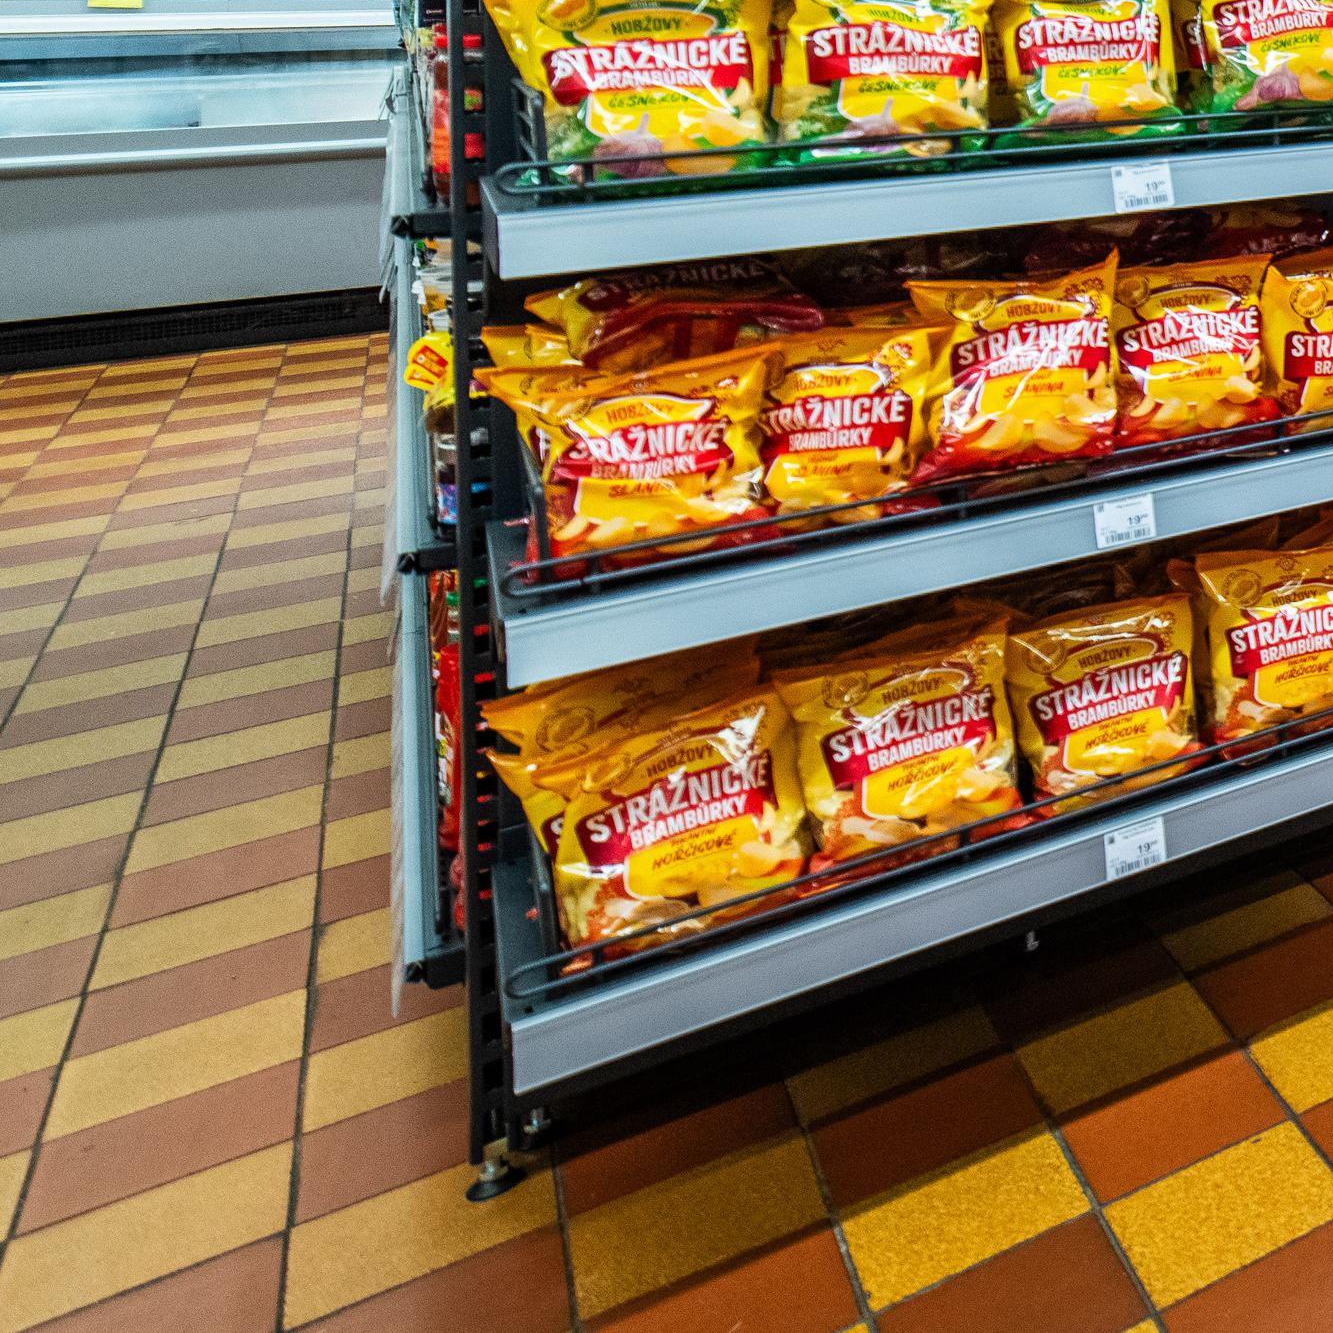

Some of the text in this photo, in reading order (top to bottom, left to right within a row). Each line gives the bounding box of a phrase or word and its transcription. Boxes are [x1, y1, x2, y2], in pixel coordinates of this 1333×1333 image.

[1251, 12, 1328, 39] BRAMBŮRKY
[849, 52, 951, 75] BRAMBŮRKY
[1068, 690, 1154, 731] BRAMBŮRKY
[867, 728, 965, 772] BRAMBŮRKY
[630, 795, 747, 849] BRAMBŮRKY
